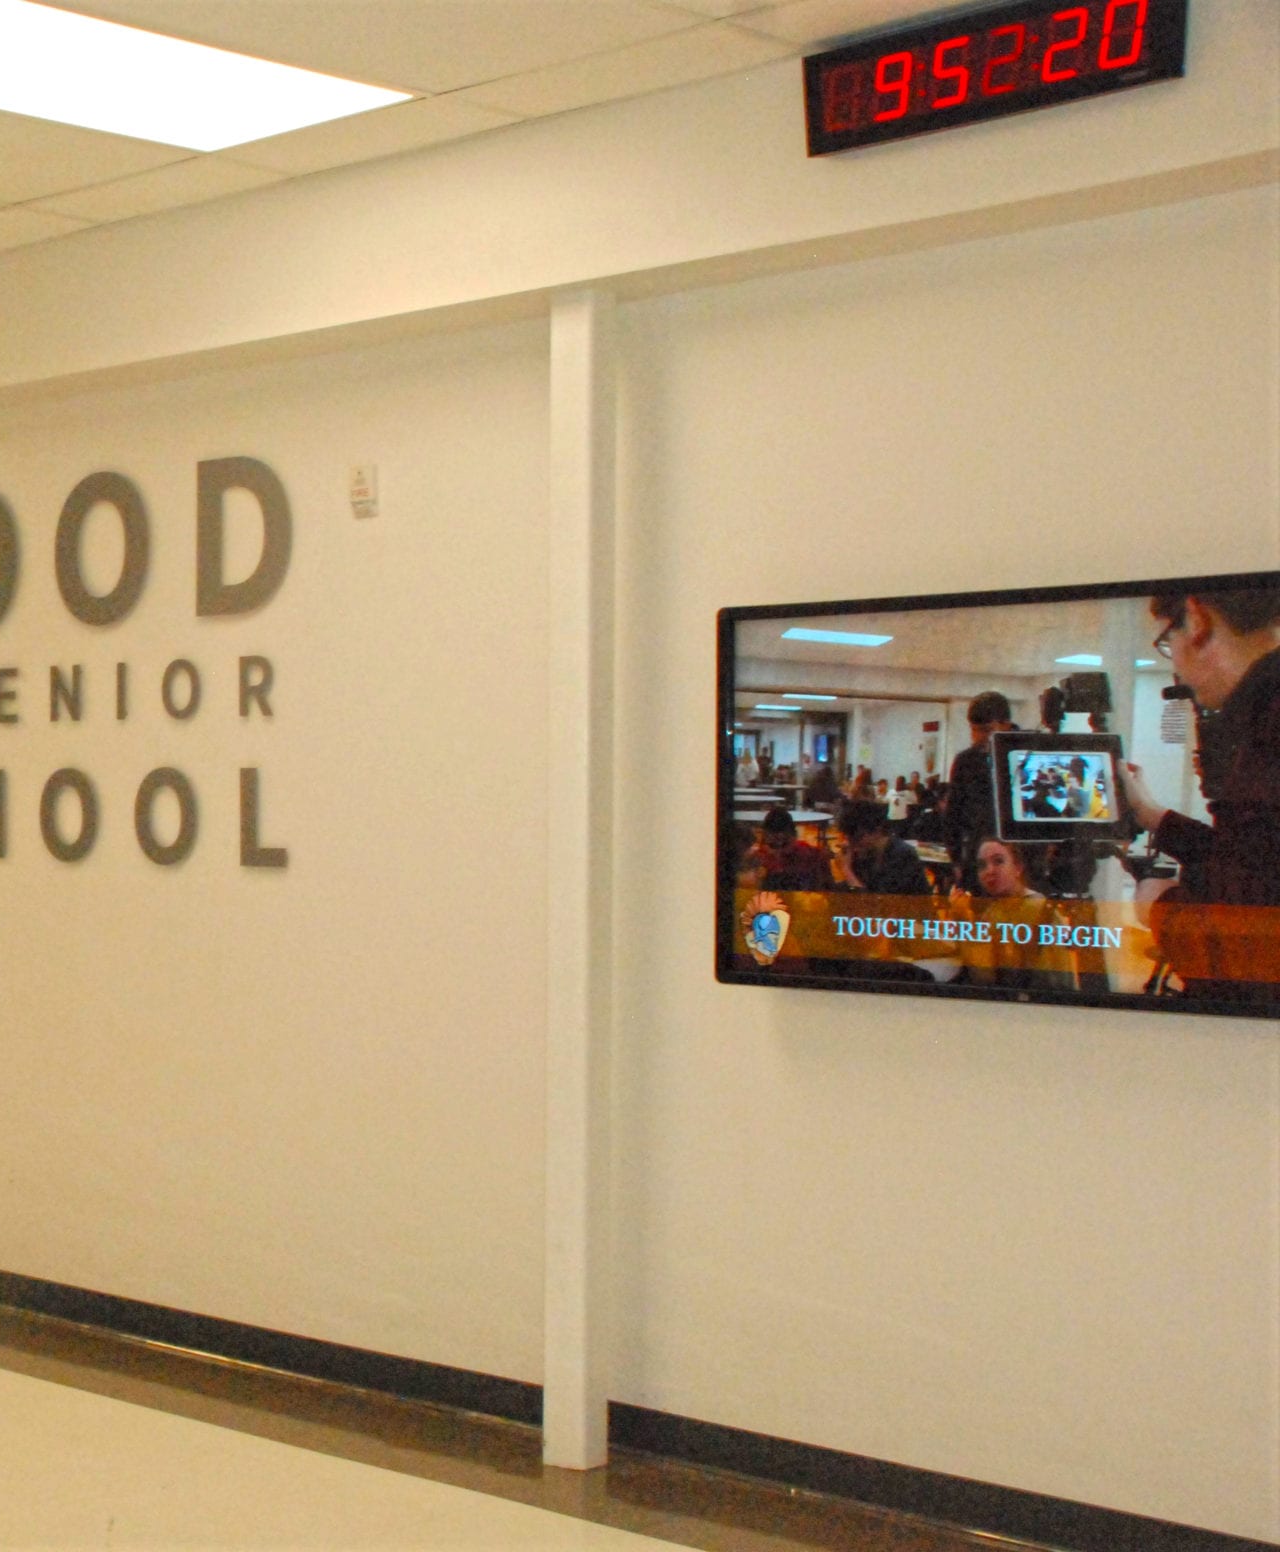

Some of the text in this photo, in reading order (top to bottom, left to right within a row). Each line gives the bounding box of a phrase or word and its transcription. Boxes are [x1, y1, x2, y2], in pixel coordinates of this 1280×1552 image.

[832, 915, 1123, 948] TOUCH HERE TO BEGIN
